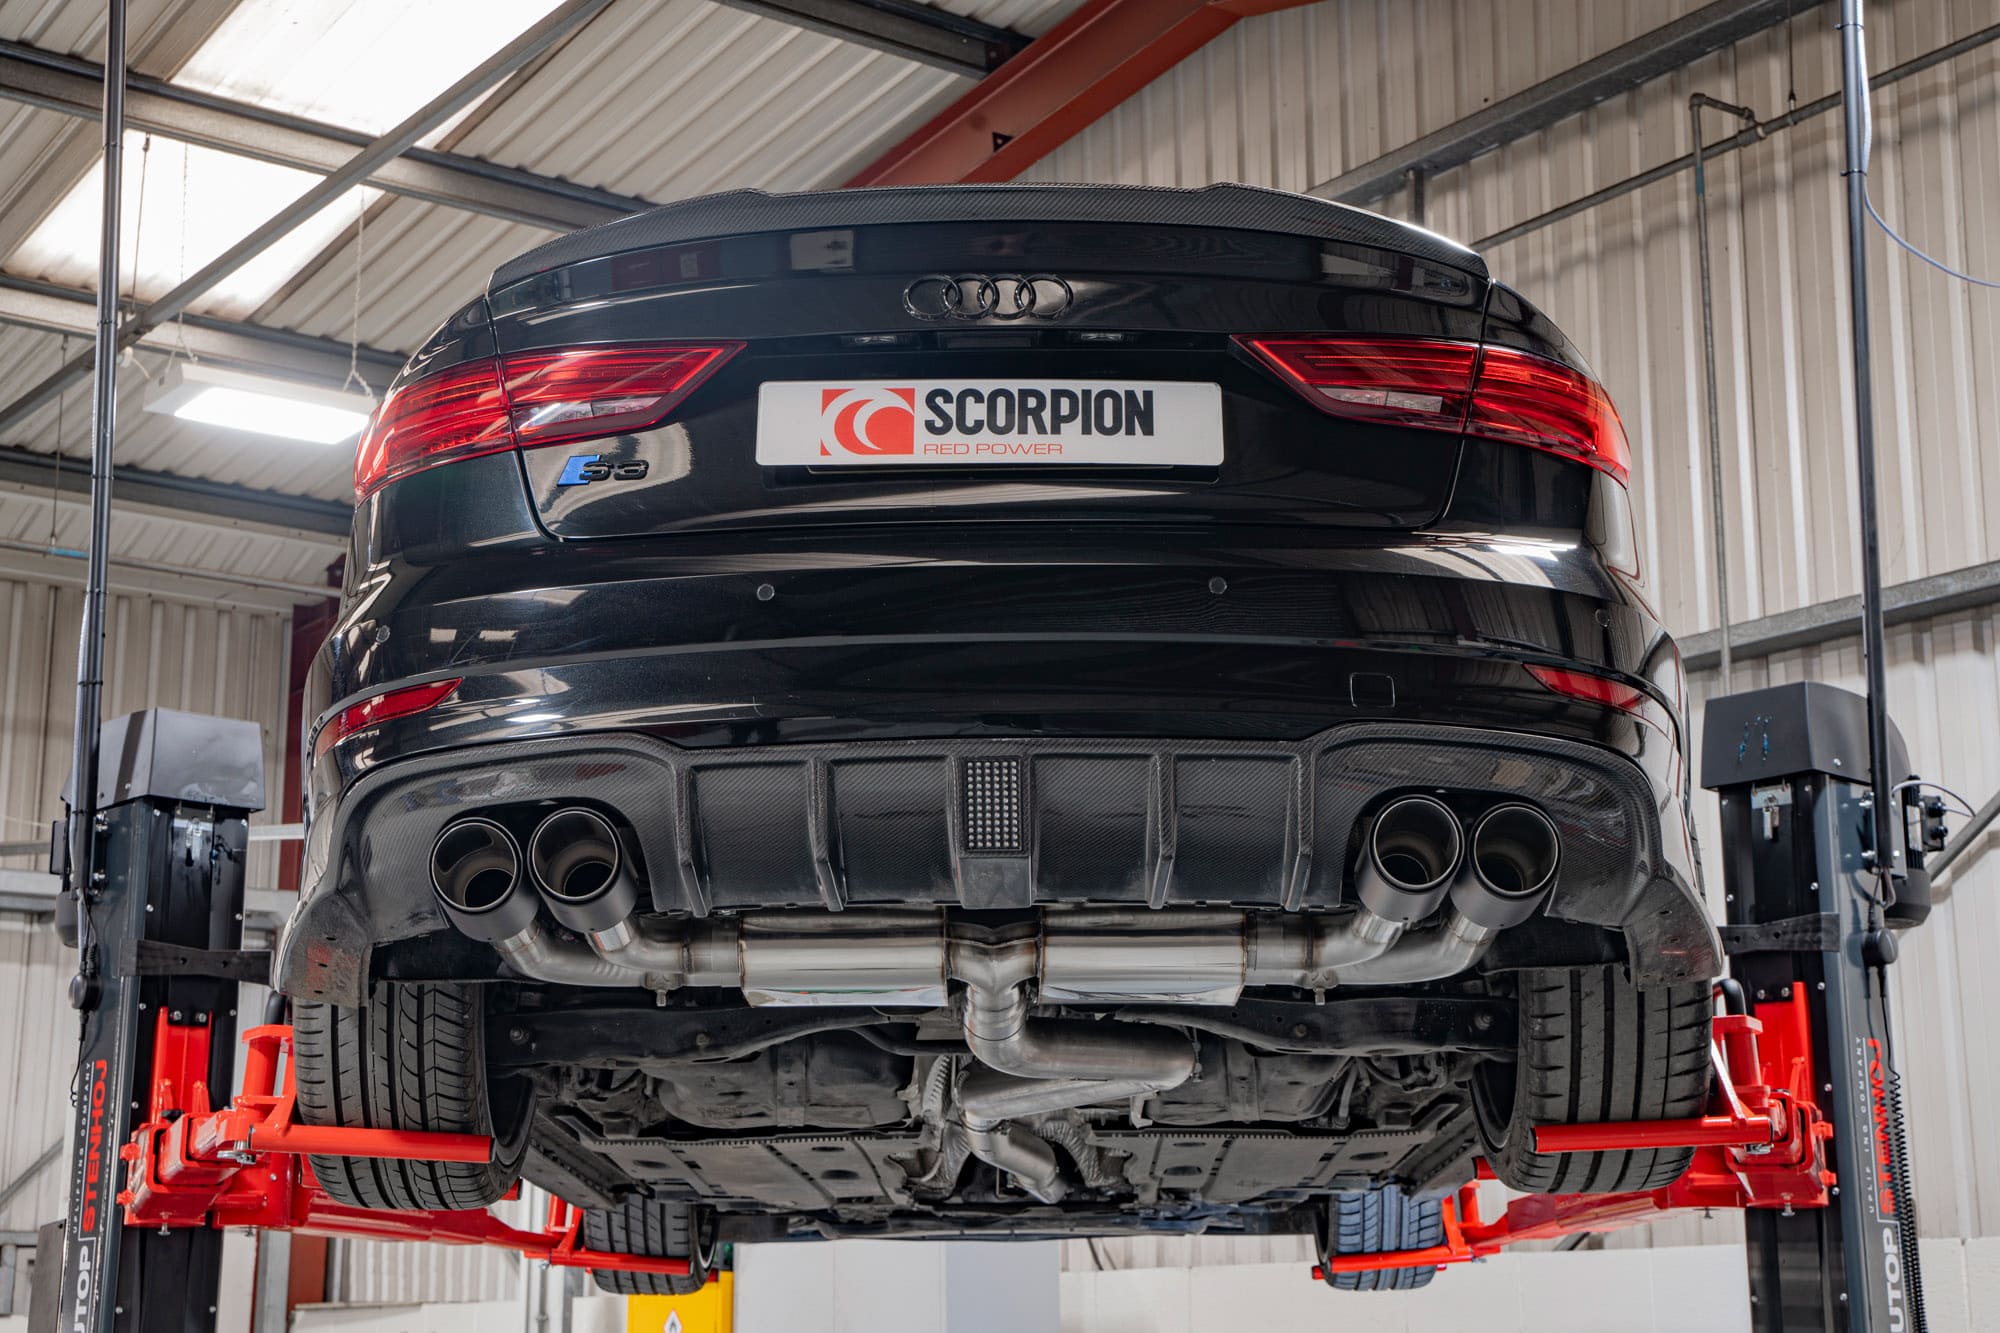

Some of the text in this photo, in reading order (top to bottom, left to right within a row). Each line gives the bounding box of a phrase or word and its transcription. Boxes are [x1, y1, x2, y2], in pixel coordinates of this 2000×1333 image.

[923, 443, 1063, 455] RED POWER
[924, 388, 1154, 436] SCORPION
[1856, 1037, 1868, 1113] COMPANY
[72, 1062, 91, 1234] UPLIFTING COMPANY
[82, 1059, 108, 1233] STENHOJ
